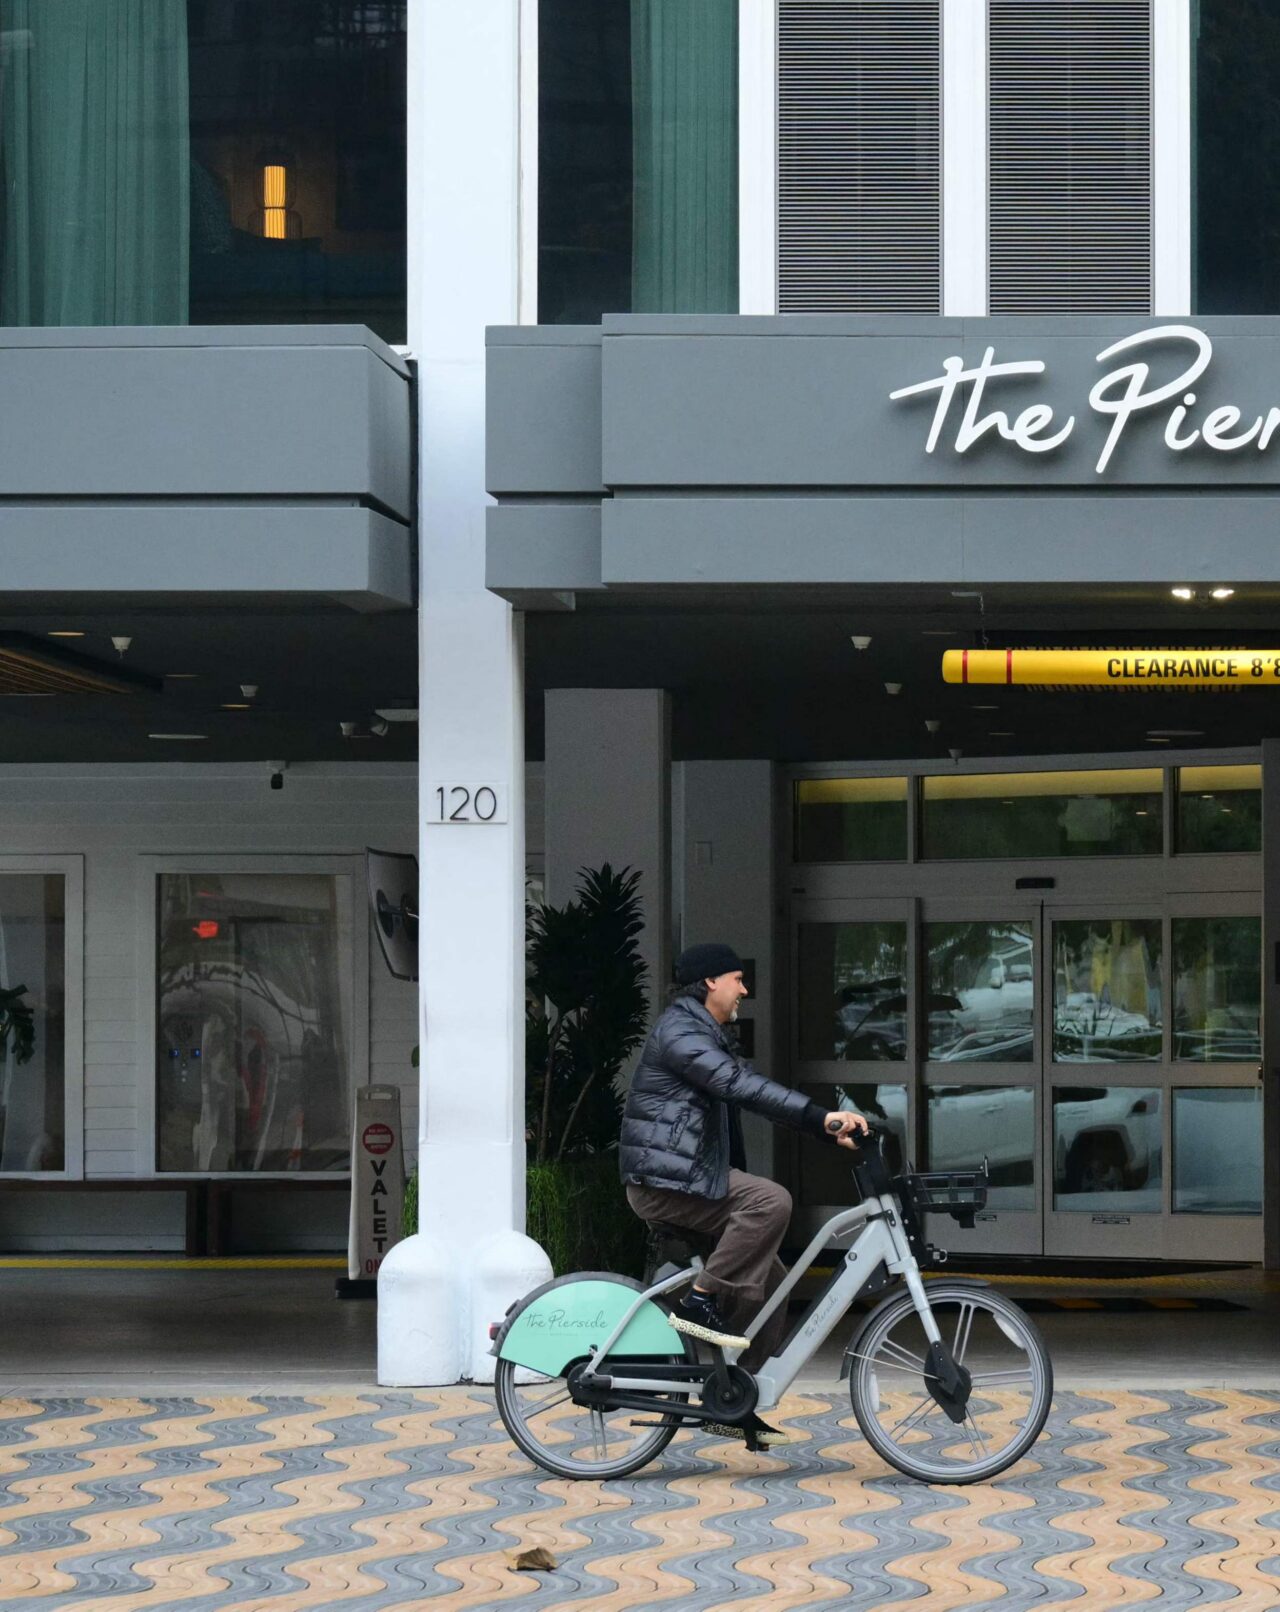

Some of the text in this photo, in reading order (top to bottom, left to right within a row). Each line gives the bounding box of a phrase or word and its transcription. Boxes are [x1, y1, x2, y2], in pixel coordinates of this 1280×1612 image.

[1107, 658, 1239, 678] CLEARANCE
[436, 786, 497, 821] 120
[370, 1159, 388, 1253] VALET
[548, 1309, 609, 1331] Pierside
